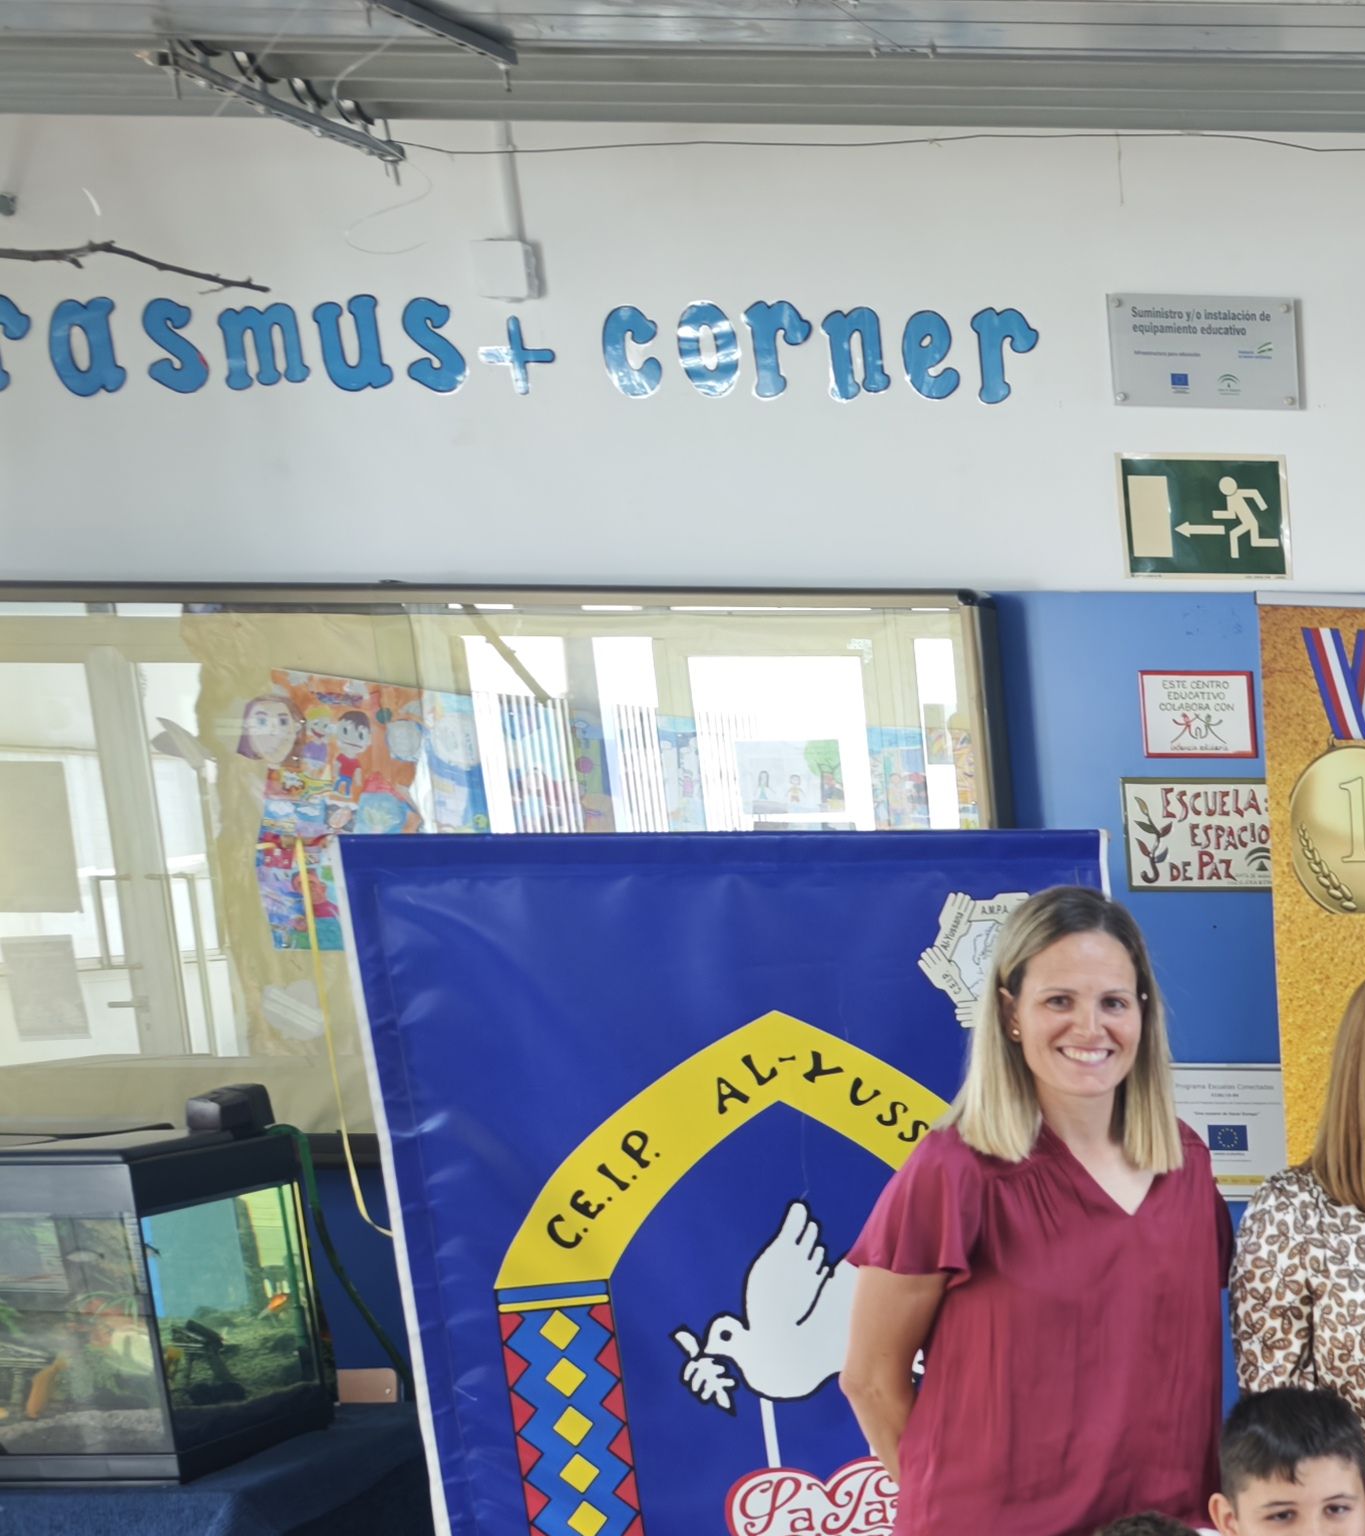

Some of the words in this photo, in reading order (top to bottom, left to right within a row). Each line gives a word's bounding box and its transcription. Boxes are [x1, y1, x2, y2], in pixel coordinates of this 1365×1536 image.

[1131, 306, 1184, 319] Suministro
[1204, 308, 1257, 321] instalación
[1259, 311, 1271, 322] de
[1132, 322, 1198, 336] equipamiento
[1200, 324, 1247, 336] educativo
[601, 299, 1039, 405] corner
[1162, 680, 1188, 690] ESTE
[1190, 680, 1230, 690] CENTRO
[1167, 691, 1226, 701] EDUCATIVO
[1159, 702, 1212, 712] COLABORA
[1213, 703, 1235, 712] CON
[1189, 822, 1270, 851] ESPACIO
[1169, 861, 1194, 882] DE
[546, 1128, 663, 1251] C.E.I.P.
[712, 1049, 931, 1143] AL-YUSS
[806, 1466, 900, 1535] Pa
